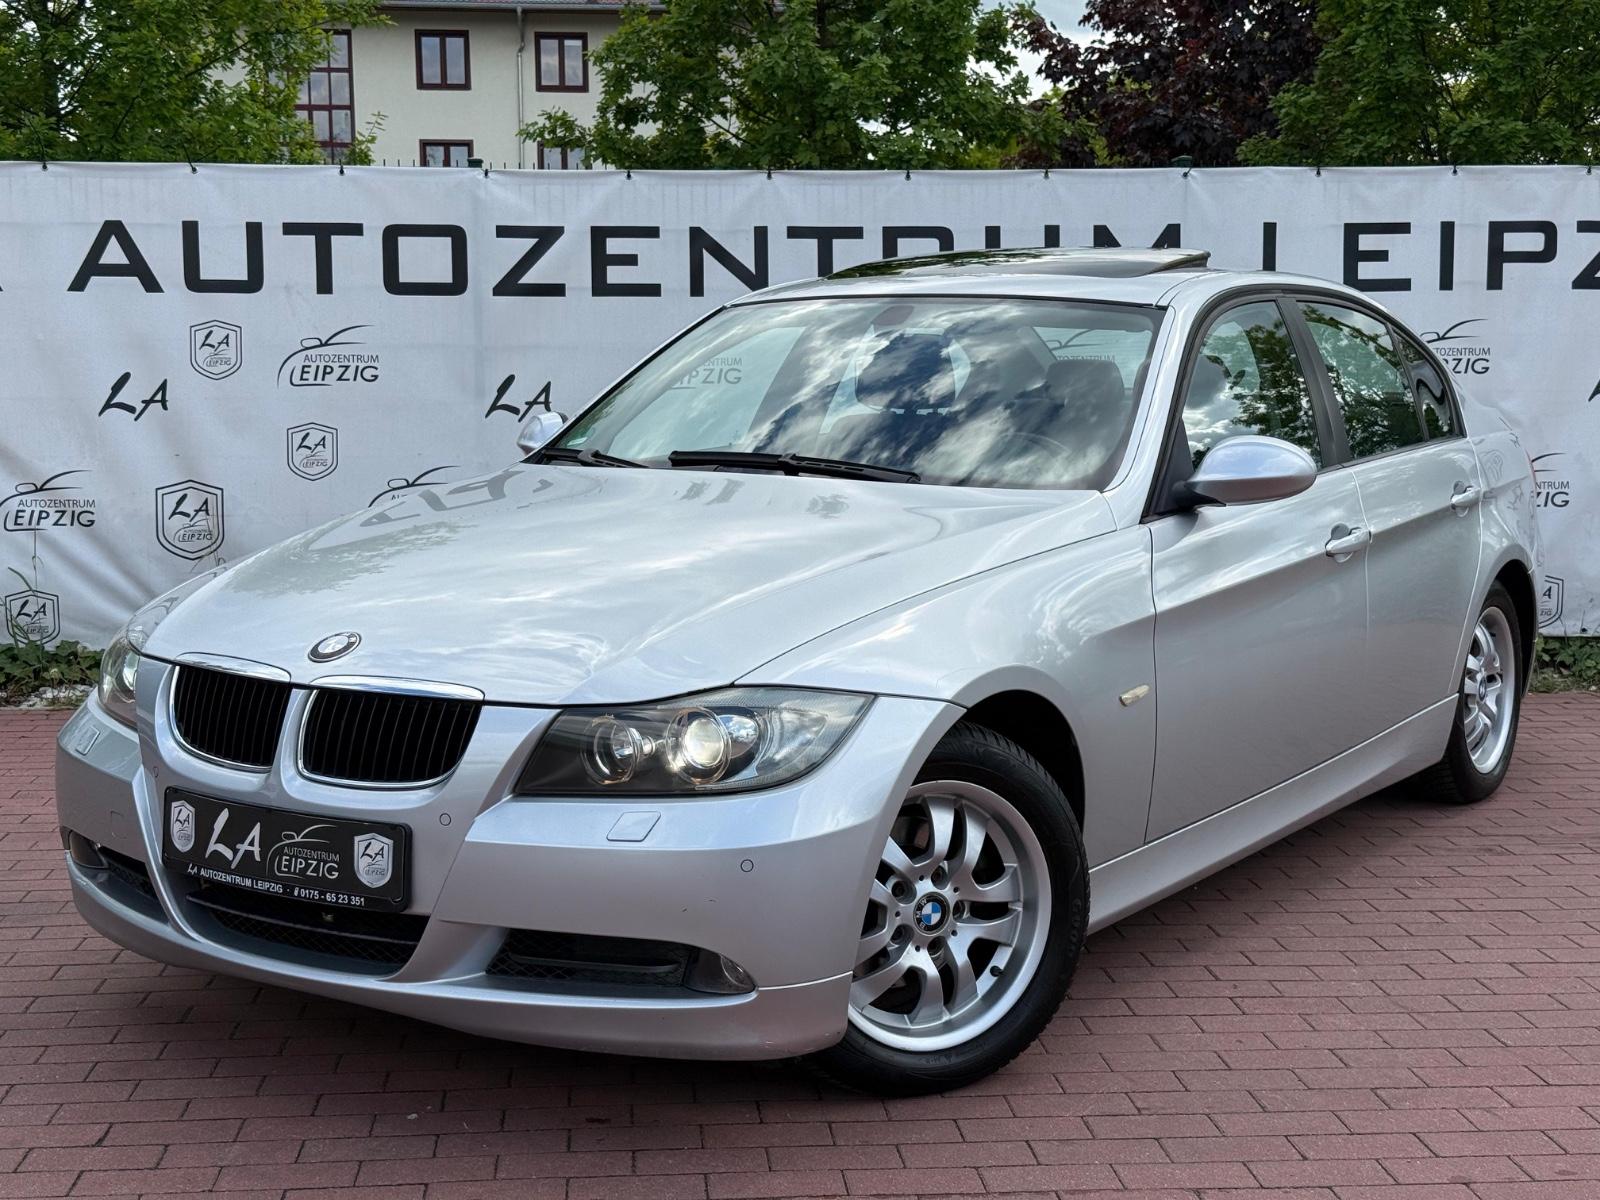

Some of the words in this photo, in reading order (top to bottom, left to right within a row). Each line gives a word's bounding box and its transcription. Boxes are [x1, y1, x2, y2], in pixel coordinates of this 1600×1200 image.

[67, 219, 1182, 298] AUTOZENT
[198, 329, 230, 352] LA
[1432, 347, 1491, 357] TOZENTRUM
[303, 353, 380, 364] AUTOZENTRUM
[98, 371, 169, 422] LA
[485, 374, 552, 423] LA
[295, 431, 326, 454] LA
[17, 498, 96, 508] AUTOZENTRUM
[168, 493, 210, 523] LA
[14, 599, 48, 622] LA
[174, 808, 191, 829] LA
[204, 807, 262, 870] LA
[283, 846, 340, 862] AUTOZENTRUM
[360, 841, 385, 863] LA
[200, 867, 253, 888] AUTOZENTRUM
[253, 879, 284, 894] LEIPZIG
[300, 888, 320, 900] 0175
[326, 892, 337, 903] 65
[338, 894, 349, 904] 23
[350, 896, 366, 906] 351
